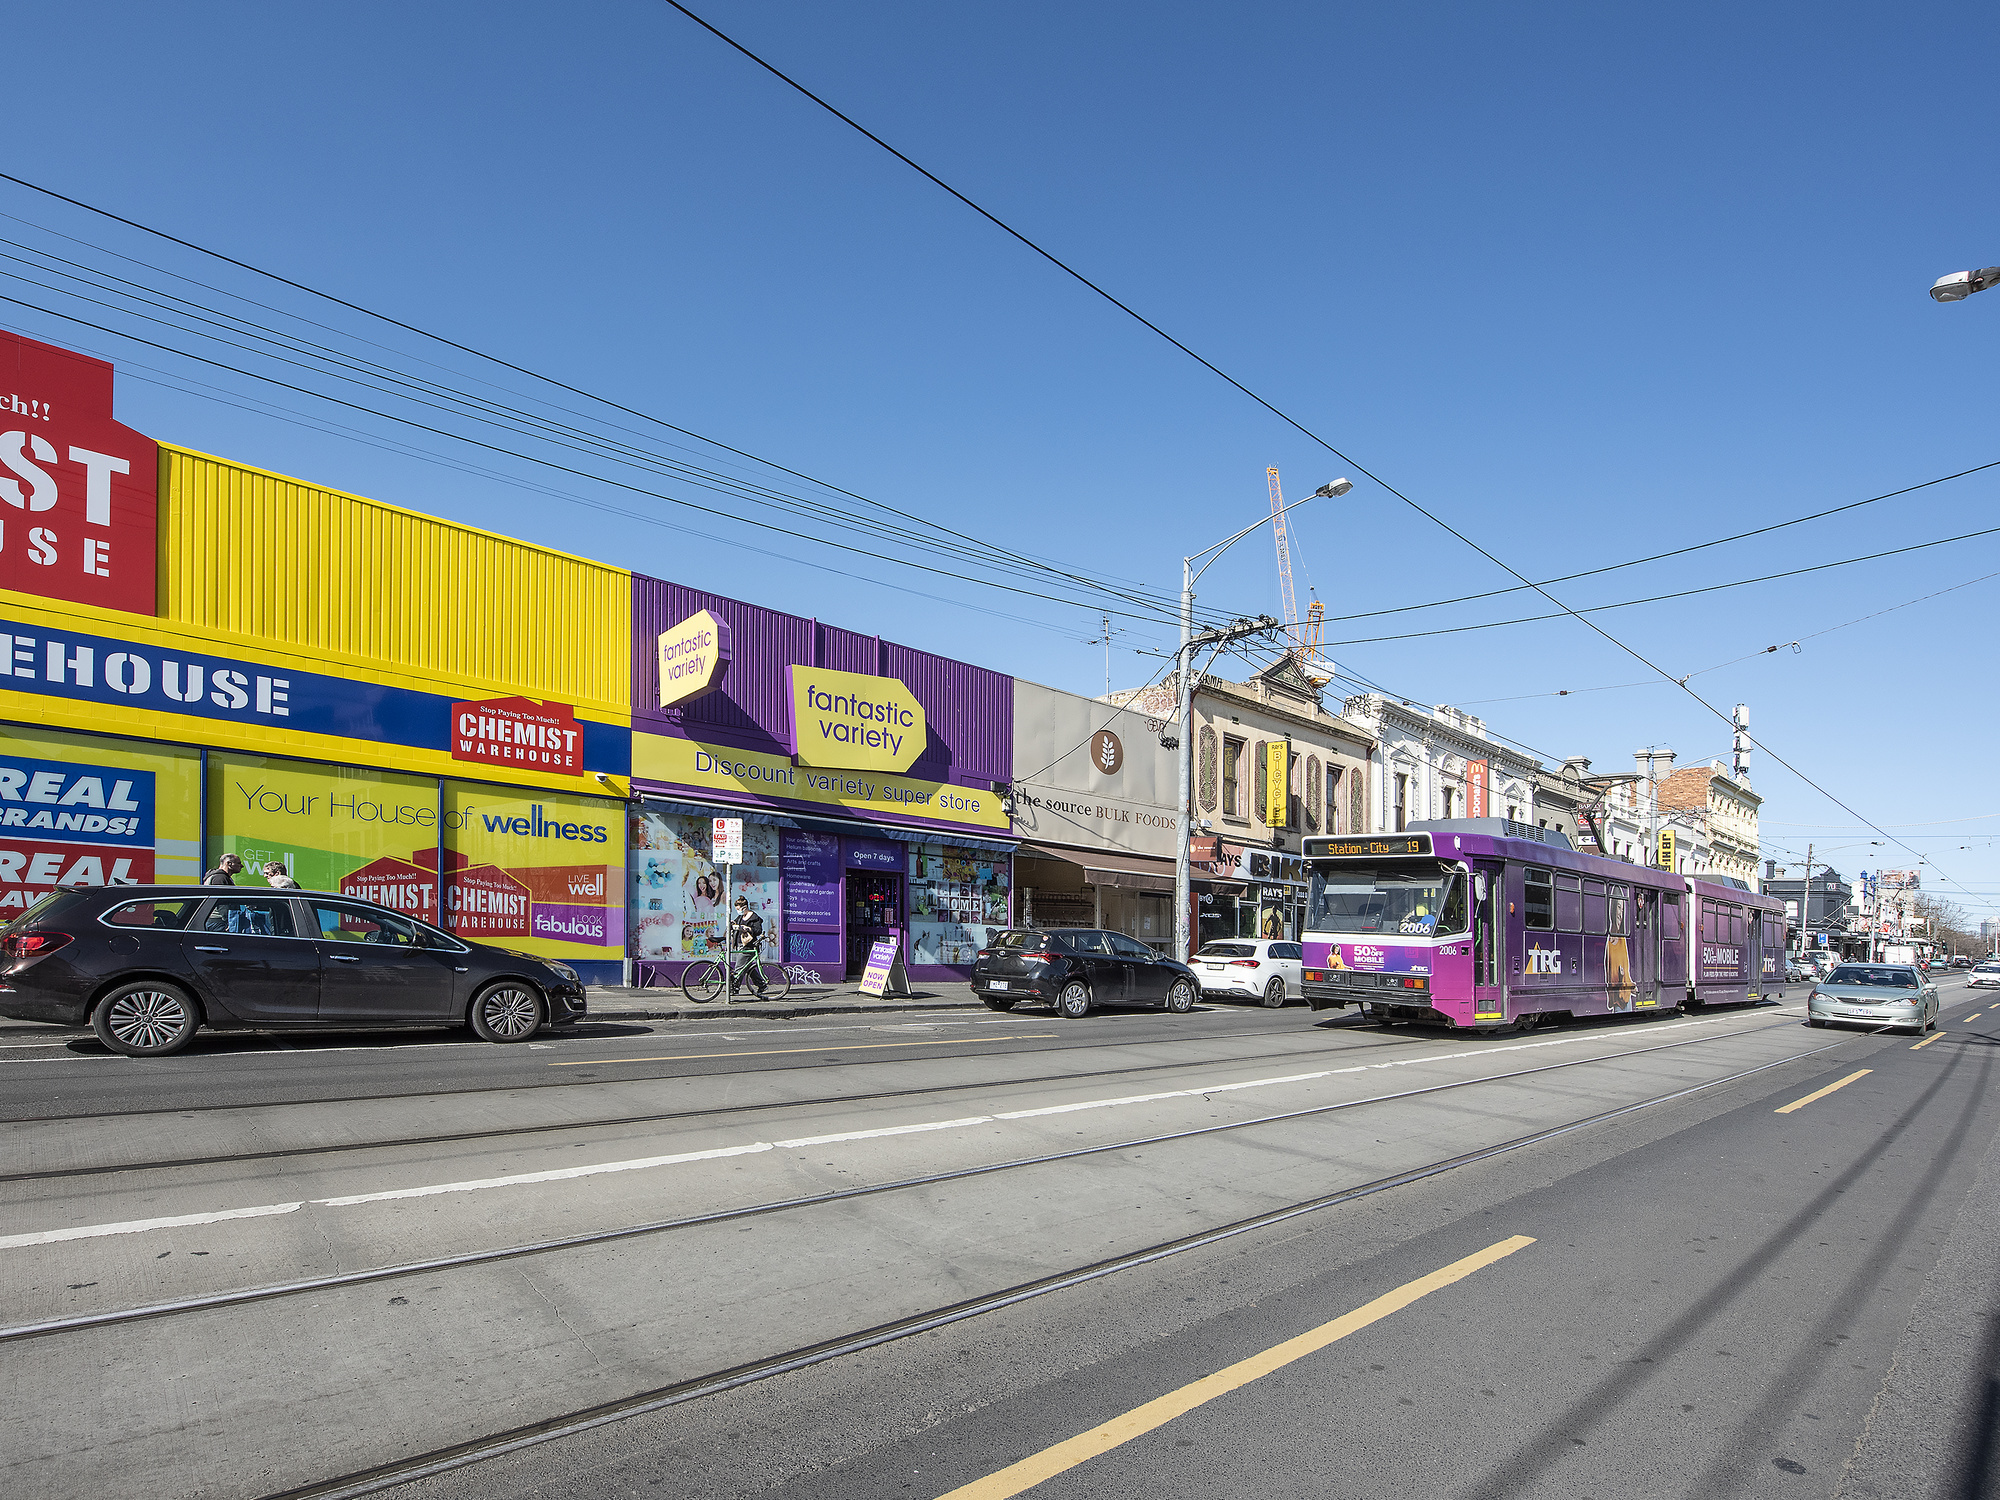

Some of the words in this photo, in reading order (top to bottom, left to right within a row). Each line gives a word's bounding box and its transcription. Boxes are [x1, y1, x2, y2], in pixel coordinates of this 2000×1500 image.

[663, 629, 712, 662] fantastic
[668, 653, 706, 681] variety
[480, 705, 496, 715] Stop
[498, 708, 521, 719] Paying
[522, 713, 535, 721] Too
[536, 715, 560, 725] Much!!
[807, 684, 914, 728] fantastic
[459, 713, 577, 752] CHEMIST
[818, 716, 904, 756] variety
[460, 739, 573, 767] WAREHOUSE
[0, 767, 139, 812] REAL
[695, 750, 795, 785] Discount
[806, 771, 876, 801] variety
[883, 784, 932, 814] super
[939, 791, 981, 813] store
[1272, 750, 1282, 818] BICYCLE
[235, 781, 319, 815] Your
[330, 792, 436, 827] House
[444, 806, 475, 830] of
[482, 804, 607, 843] wellness
[1015, 788, 1041, 807] the
[1046, 797, 1092, 816] source
[1096, 806, 1130, 823] BULK
[1135, 812, 1177, 830] FOODS
[1407, 841, 1419, 852] 19
[1662, 833, 1671, 849] JB
[243, 848, 275, 861] GET
[243, 852, 294, 878] wll
[853, 851, 872, 860] Open
[878, 853, 895, 862] days
[0, 850, 139, 885] REAL
[368, 874, 385, 882] Paying
[1250, 852, 1306, 881] BIK
[463, 876, 476, 885] Stop
[476, 879, 493, 887] Paying
[568, 874, 590, 884] LIVE
[568, 873, 604, 896] well
[447, 885, 527, 916] CHEMIST
[448, 915, 525, 929] WAREHOUSE
[535, 914, 603, 938] fabulous
[577, 915, 602, 925] LOOK
[1400, 922, 1431, 934] 2006
[872, 952, 892, 963] variety
[1438, 945, 1457, 956] 2006
[1717, 948, 1739, 964] MOBILE
[863, 979, 883, 989] OPEN
[867, 971, 885, 981] NOW
